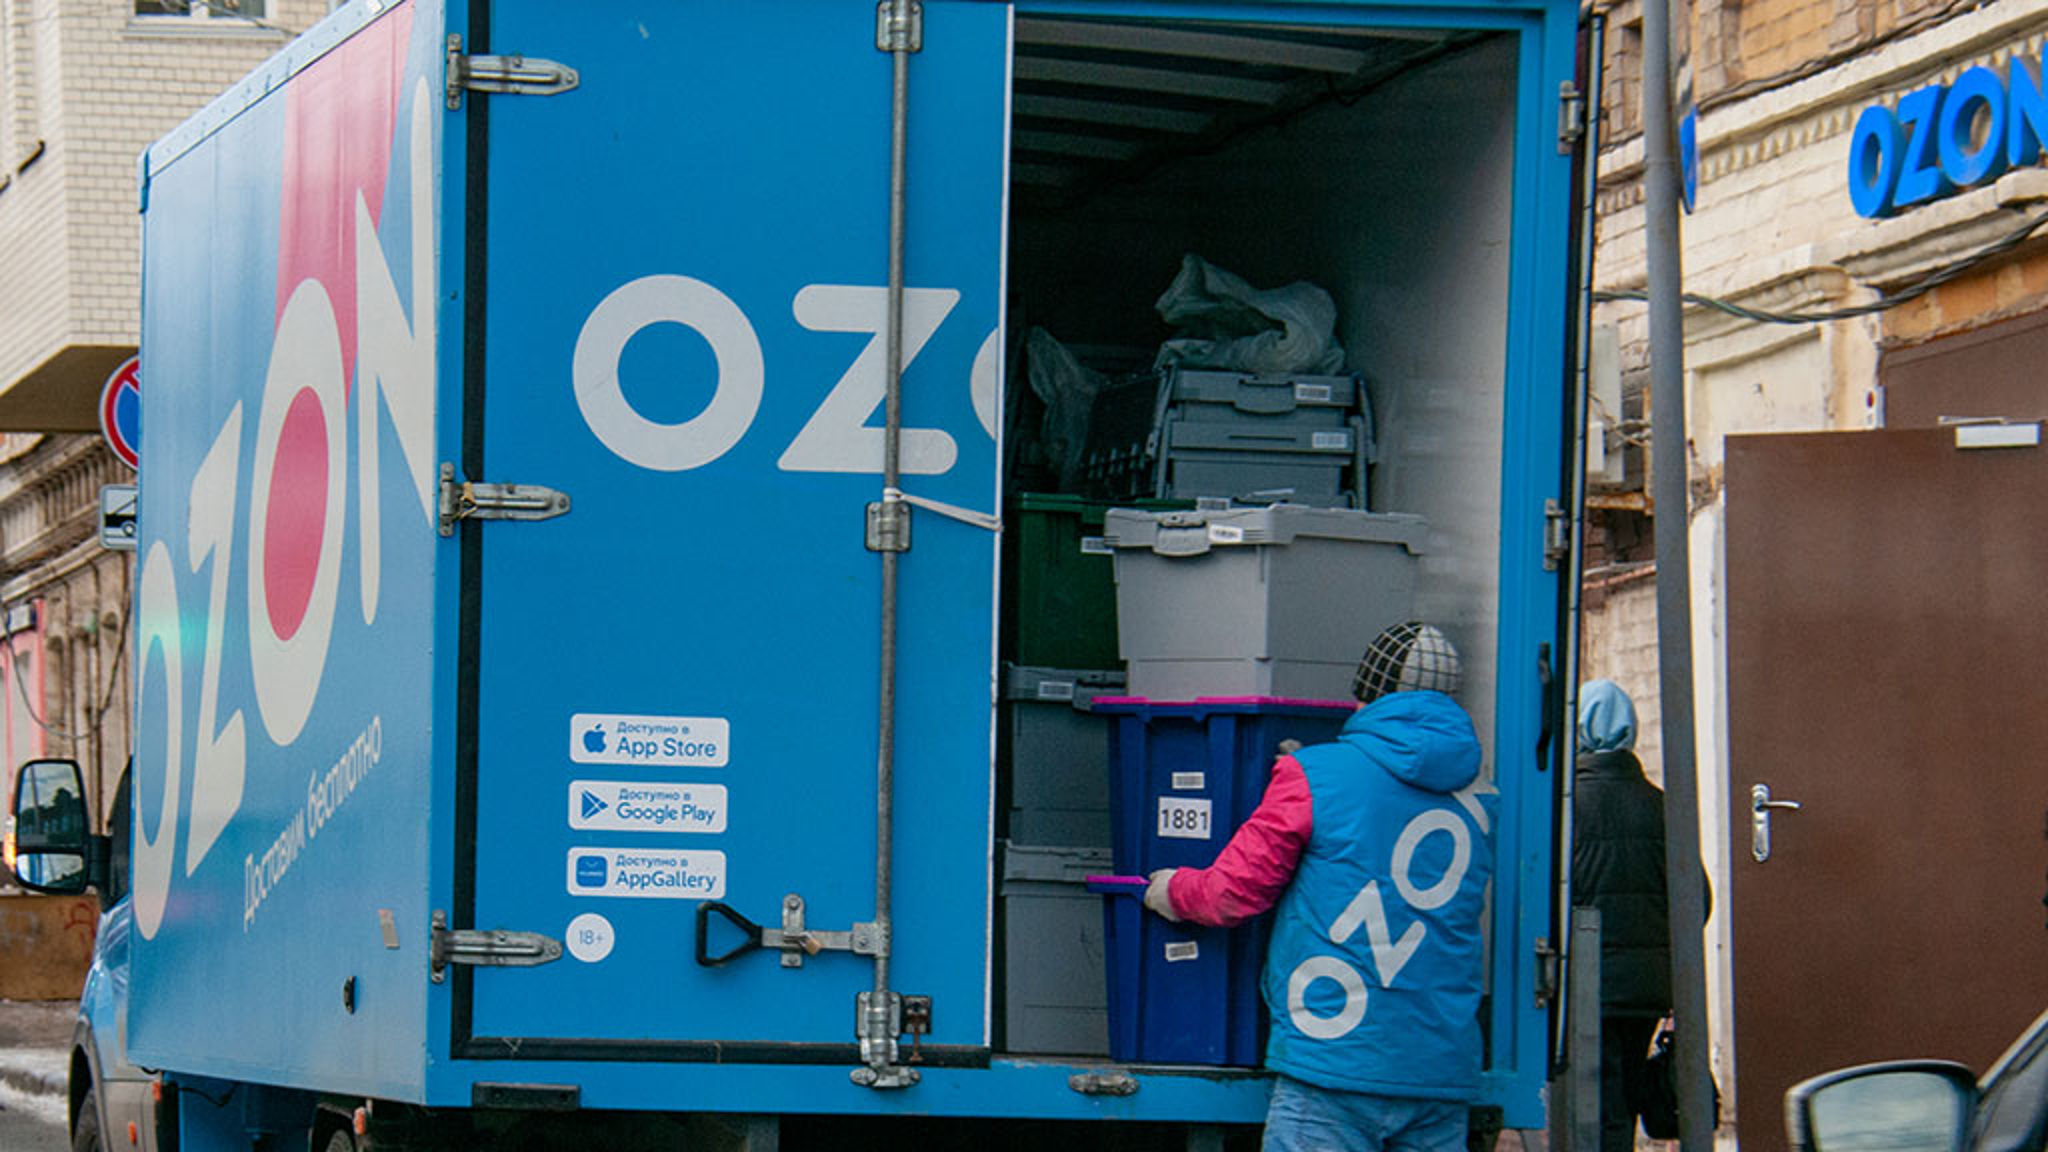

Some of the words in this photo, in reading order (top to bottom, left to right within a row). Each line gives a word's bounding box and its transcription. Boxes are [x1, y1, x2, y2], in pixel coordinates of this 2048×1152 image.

[1847, 40, 2048, 219] OZON
[572, 273, 998, 475] OZ
[133, 74, 436, 941] OZON
[617, 721, 678, 736] Доступно
[616, 737, 658, 758] App
[663, 738, 717, 757] Store
[619, 788, 680, 802] Доступно
[244, 808, 306, 934] Доставим
[308, 714, 382, 839] бесплатно
[616, 802, 678, 824] Google
[681, 804, 716, 825] Play
[1162, 809, 1208, 831] 1881
[615, 854, 677, 868] Доступно
[615, 870, 717, 893] AppGallery
[579, 929, 604, 946] 18+
